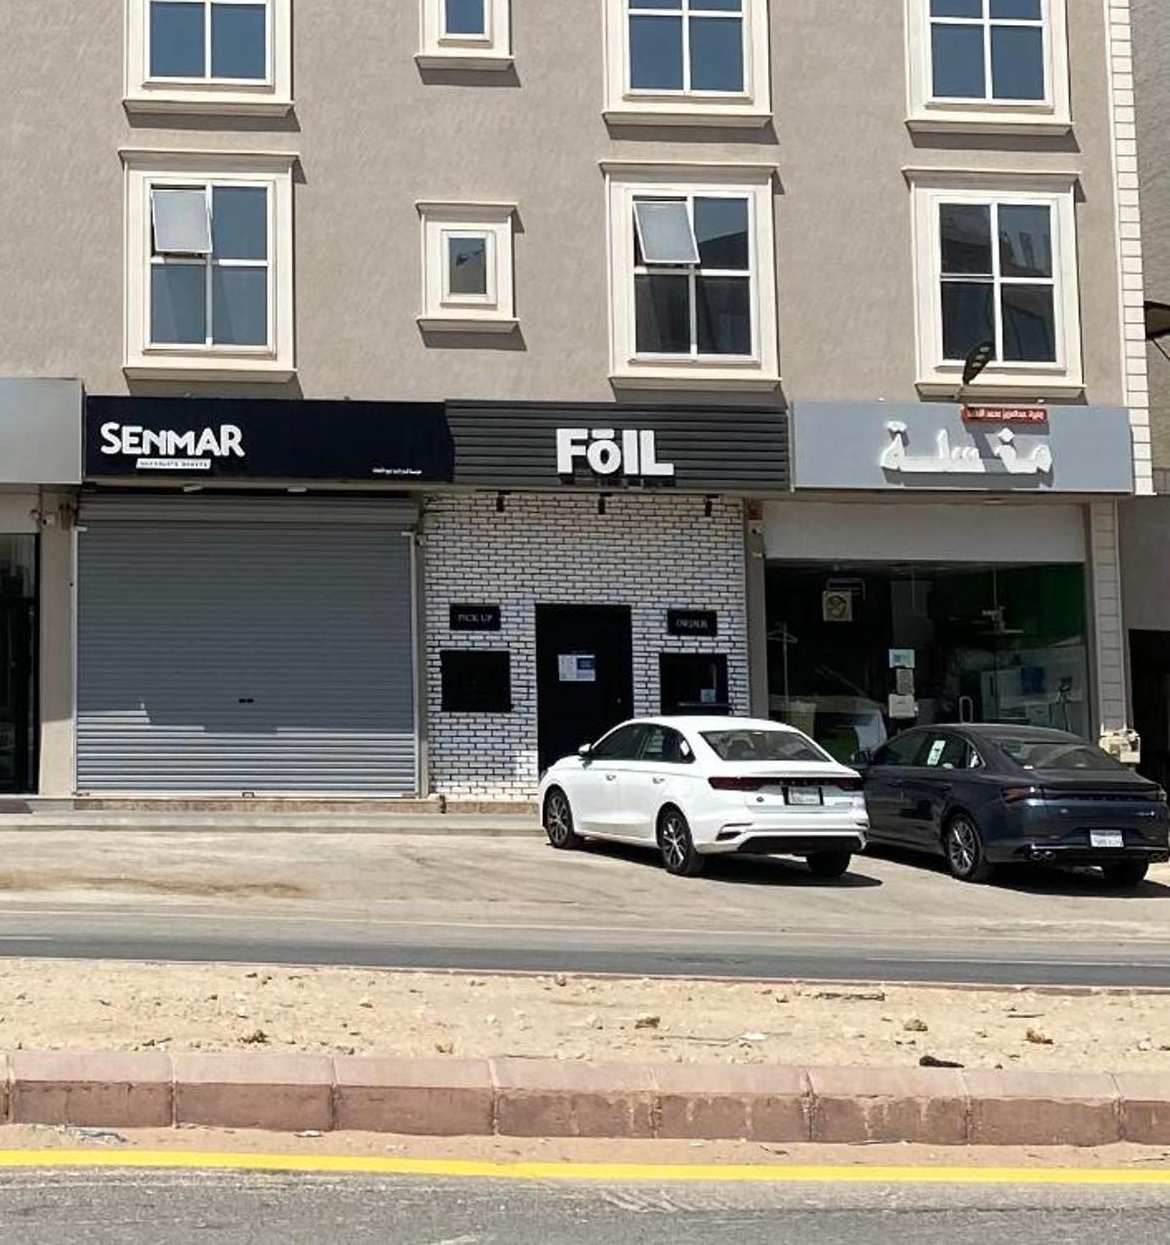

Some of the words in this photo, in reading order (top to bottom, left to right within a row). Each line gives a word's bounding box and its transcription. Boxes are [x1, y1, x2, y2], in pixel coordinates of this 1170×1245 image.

[100, 422, 245, 457] SENMAR
[880, 420, 1053, 474] مغسلة
[676, 619, 708, 629] ORDER
